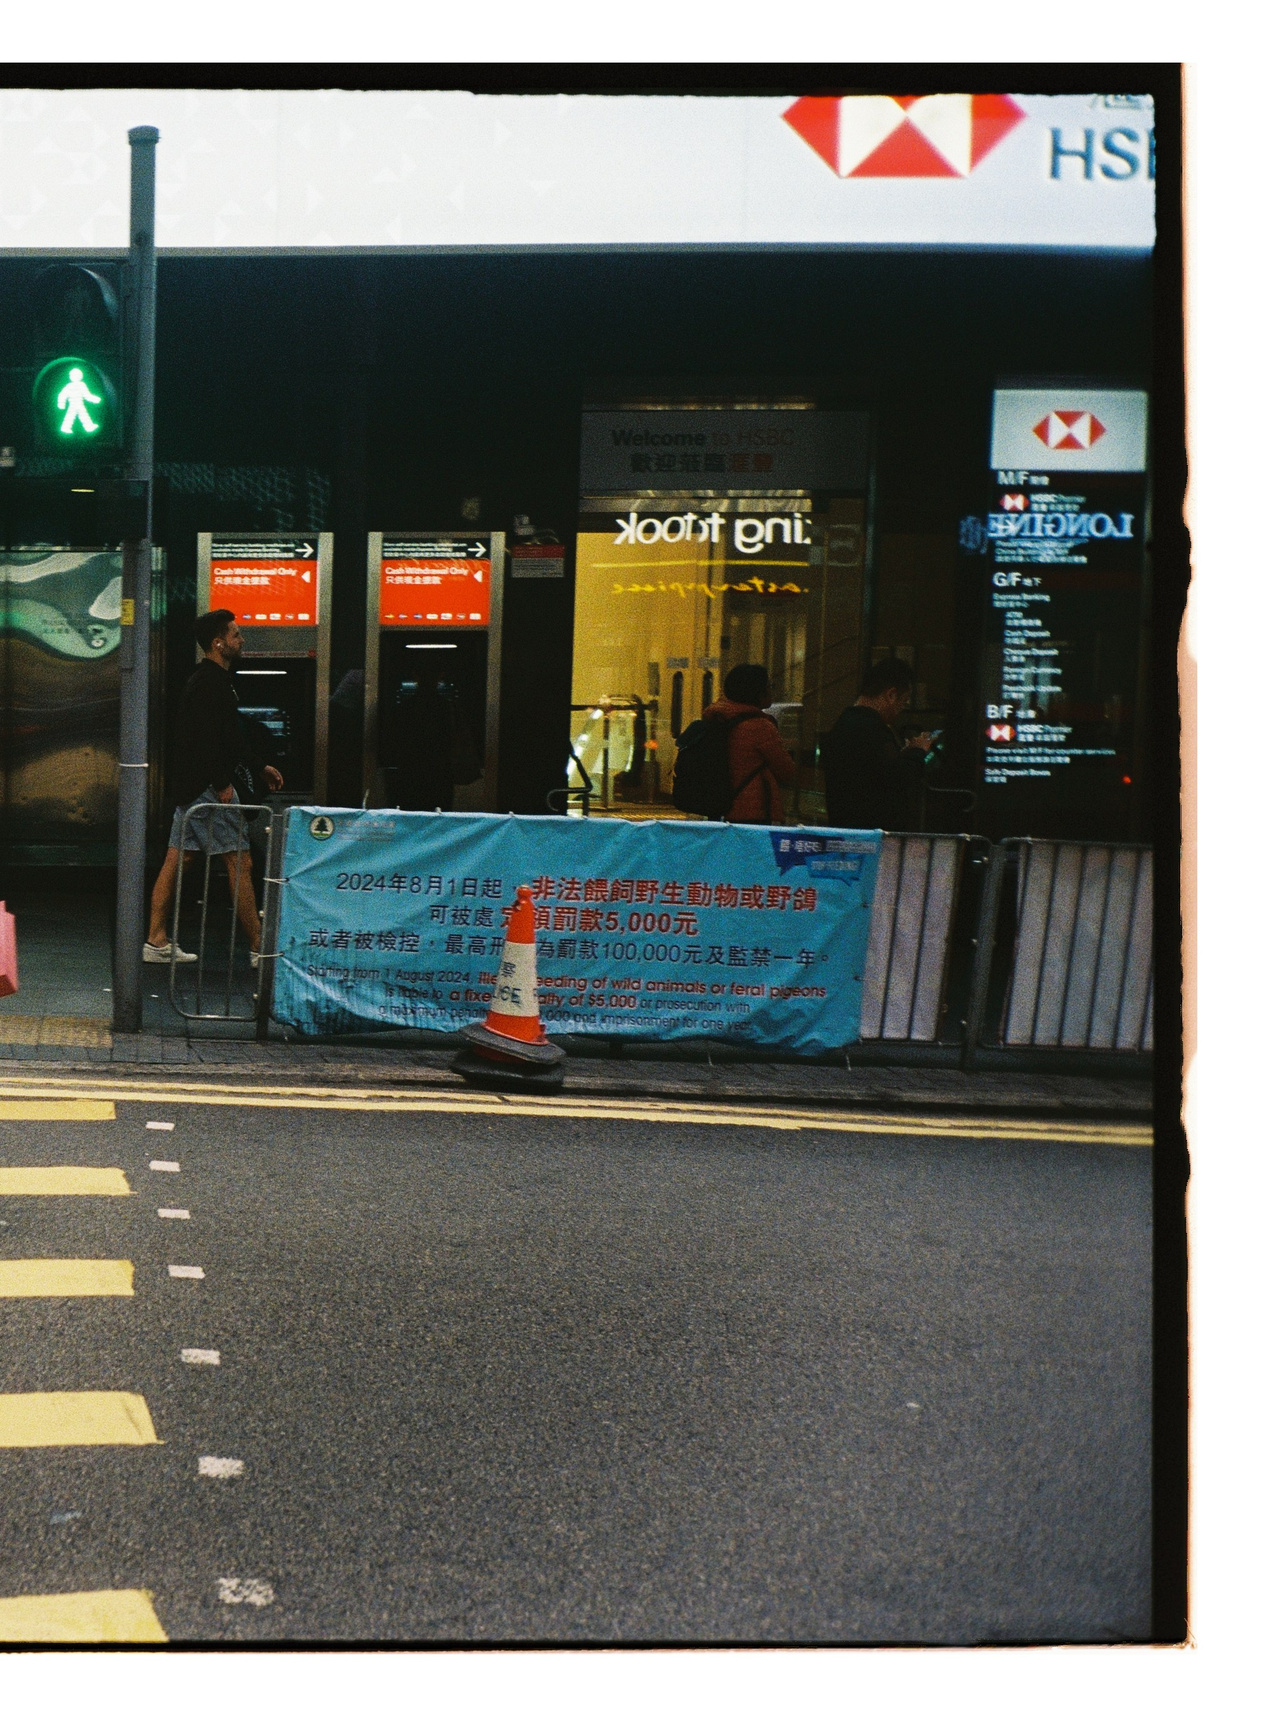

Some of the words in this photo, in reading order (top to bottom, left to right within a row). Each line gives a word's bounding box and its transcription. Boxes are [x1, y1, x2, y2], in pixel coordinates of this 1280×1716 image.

[1049, 126, 1155, 181] HS
[611, 429, 707, 447] Welcome
[737, 428, 795, 447] HSBC
[277, 567, 299, 577] Only
[449, 566, 470, 577] Only
[307, 963, 350, 980] Starting
[353, 965, 381, 979] from
[396, 968, 435, 984] August
[536, 976, 588, 992] eeding
[591, 976, 608, 990] of
[610, 978, 642, 991] wild
[645, 979, 707, 995] animals
[710, 982, 726, 995] or
[729, 981, 766, 997] feral
[769, 984, 827, 1000] pigeons
[449, 990, 460, 1001] a
[464, 988, 493, 1002] fixe
[537, 992, 565, 1007] alty
[568, 993, 585, 1007] of
[588, 992, 637, 1009] $5,000
